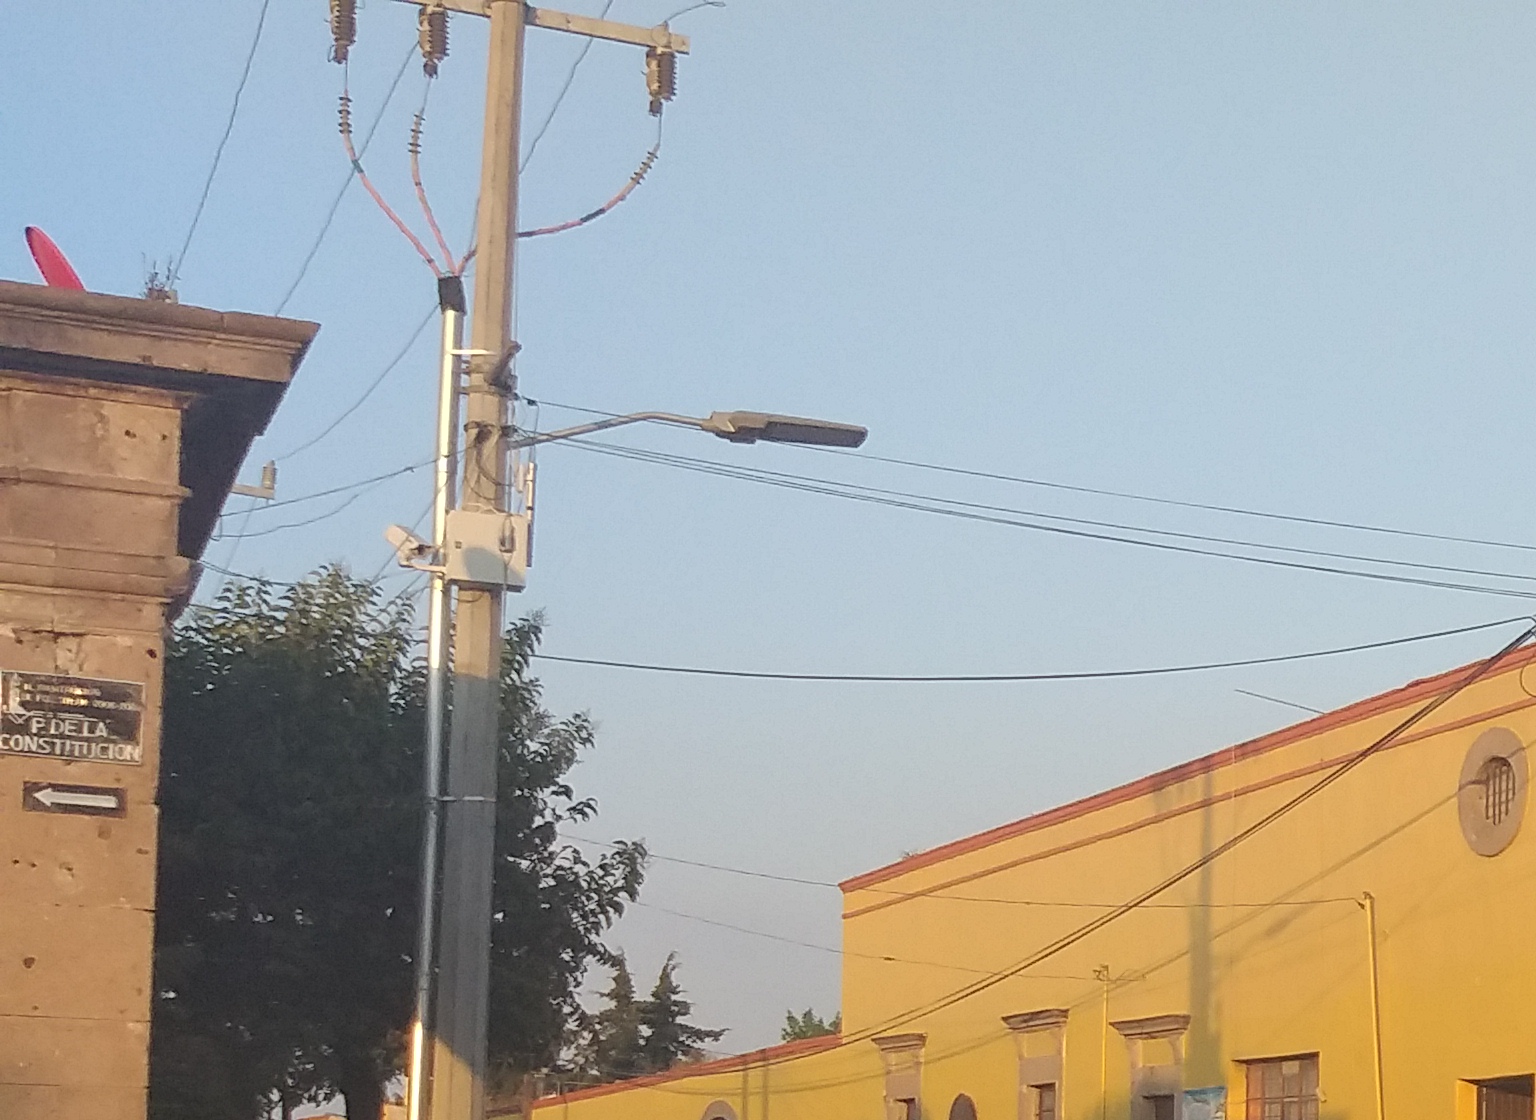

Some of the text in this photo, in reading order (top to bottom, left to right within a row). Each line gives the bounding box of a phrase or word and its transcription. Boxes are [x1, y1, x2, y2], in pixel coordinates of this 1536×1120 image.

[50, 718, 79, 736] DE
[82, 720, 108, 738] LA
[0, 733, 141, 761] CONSTITUCION
